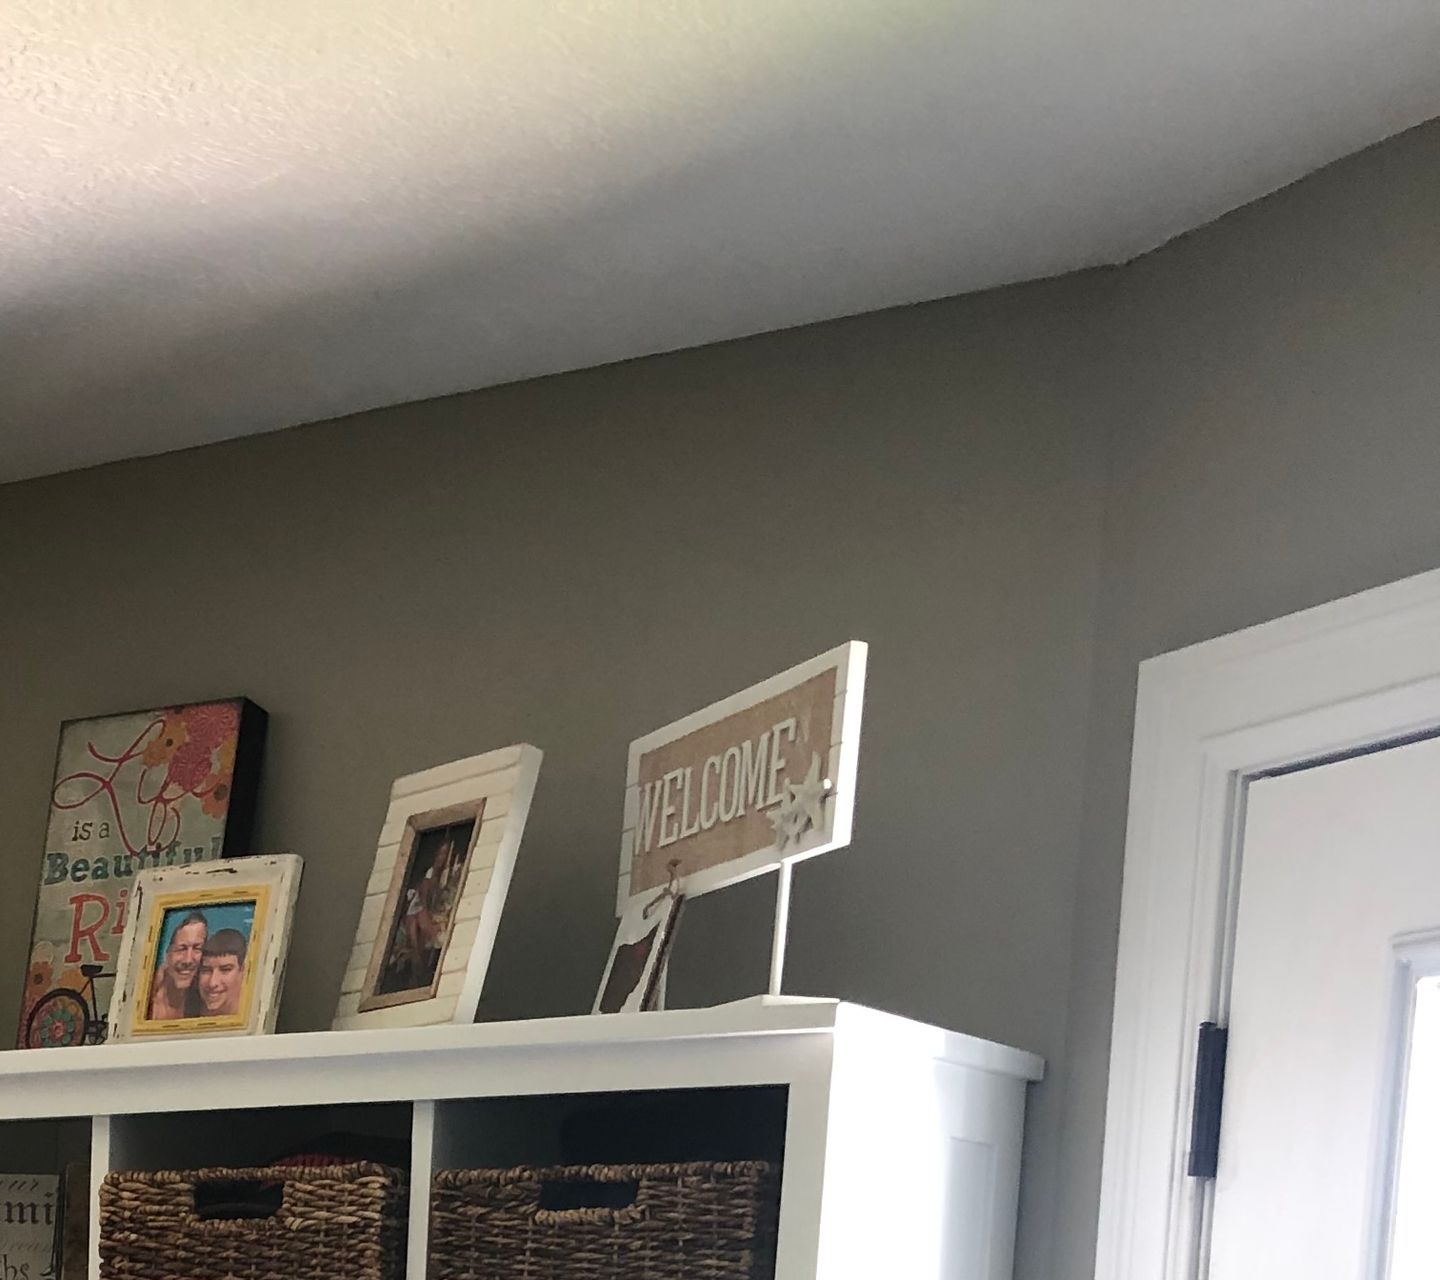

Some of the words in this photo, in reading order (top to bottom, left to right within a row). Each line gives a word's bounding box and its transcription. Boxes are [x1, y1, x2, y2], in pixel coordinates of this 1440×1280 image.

[633, 717, 797, 856] WELCOME
[72, 820, 93, 841] is
[98, 821, 110, 839] a
[64, 890, 129, 963] Ri
